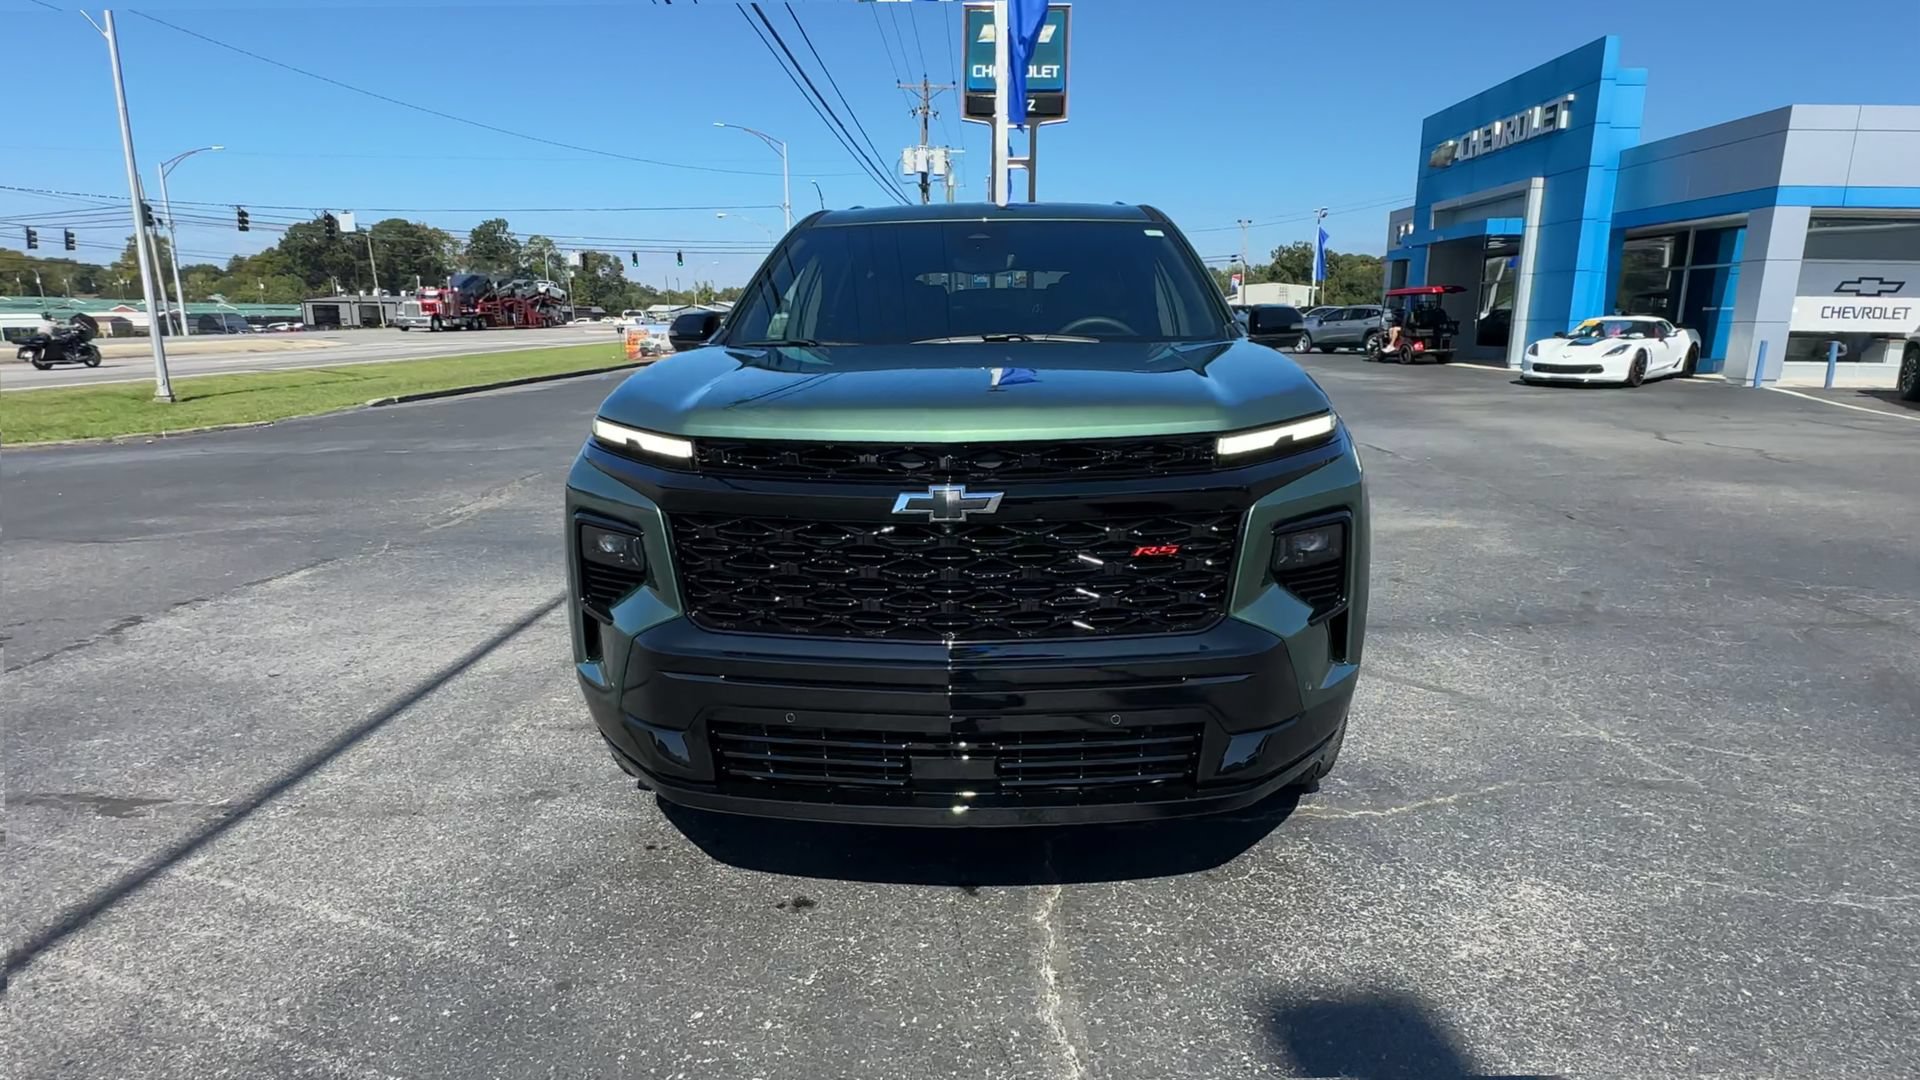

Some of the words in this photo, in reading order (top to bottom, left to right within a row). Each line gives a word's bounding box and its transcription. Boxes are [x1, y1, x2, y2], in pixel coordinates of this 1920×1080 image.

[1458, 93, 1575, 161] CHEVROLET
[1821, 306, 1911, 320] CHEVROLET
[1131, 545, 1180, 556] RS
